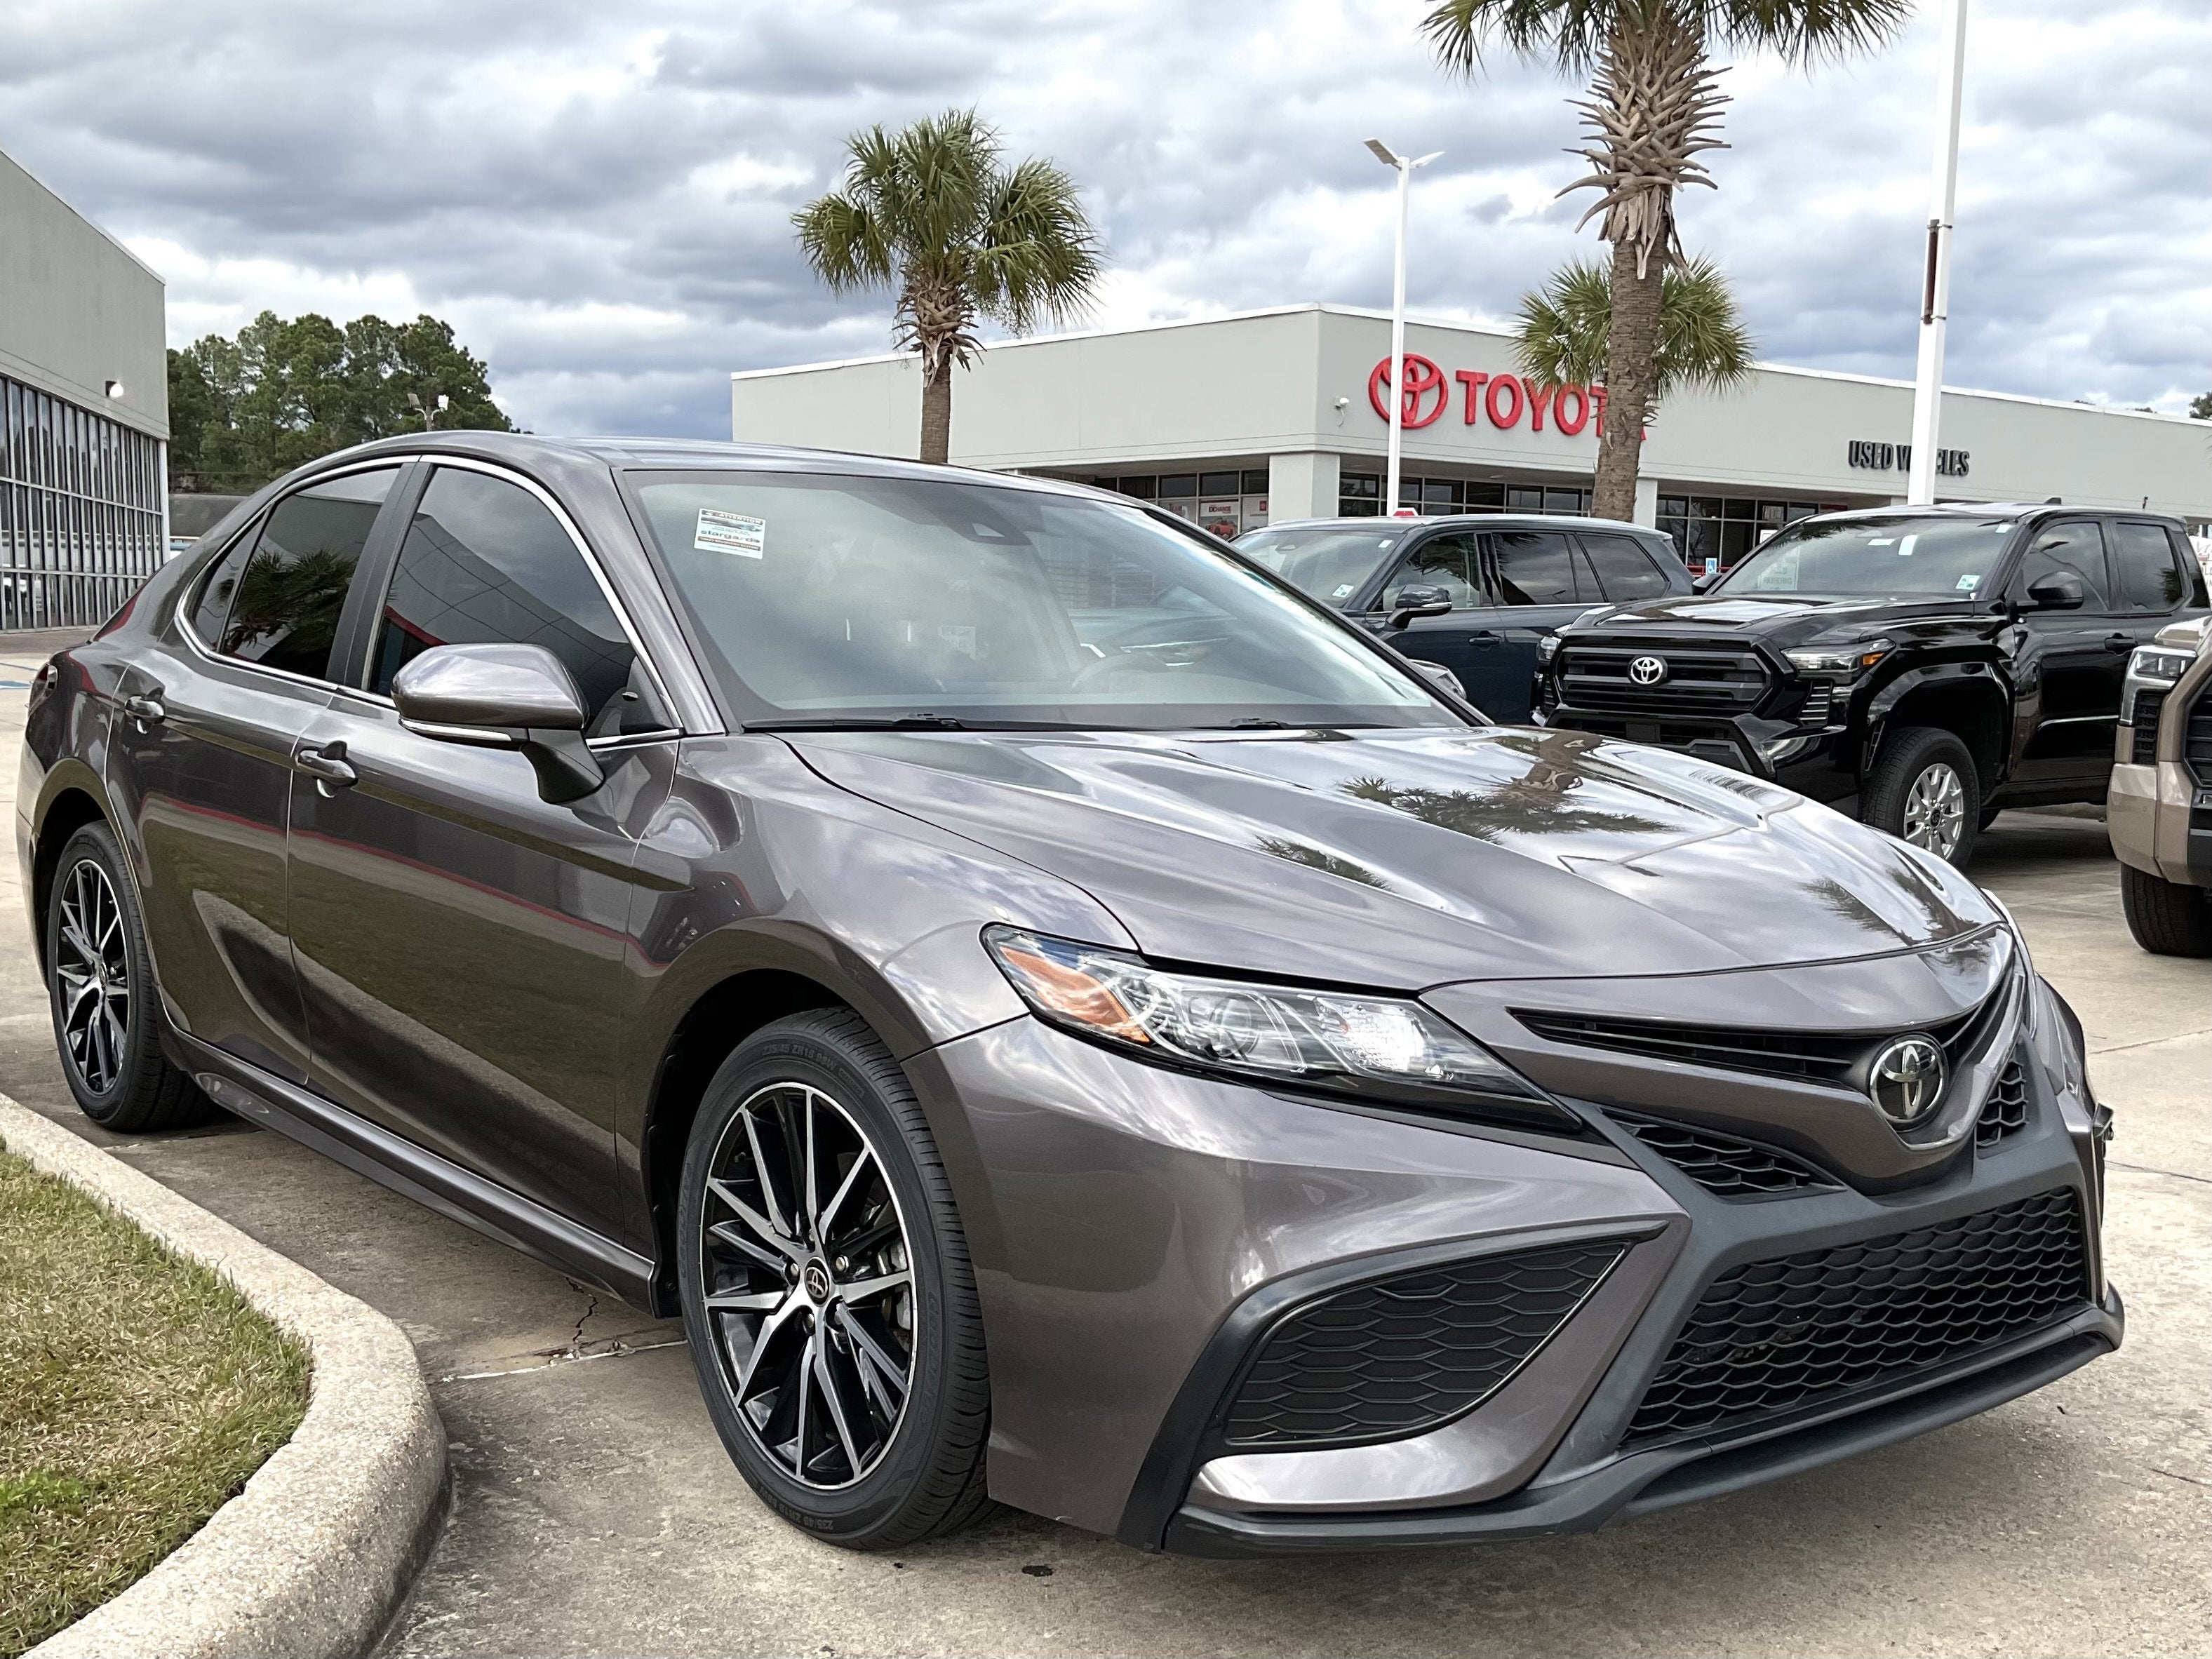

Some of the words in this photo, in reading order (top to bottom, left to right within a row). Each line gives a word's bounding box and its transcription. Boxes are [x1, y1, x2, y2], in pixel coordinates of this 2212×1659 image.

[1456, 370, 1646, 441] TOYOT
[1848, 441, 1894, 469] USED
[1896, 445, 1970, 476] VCLES
